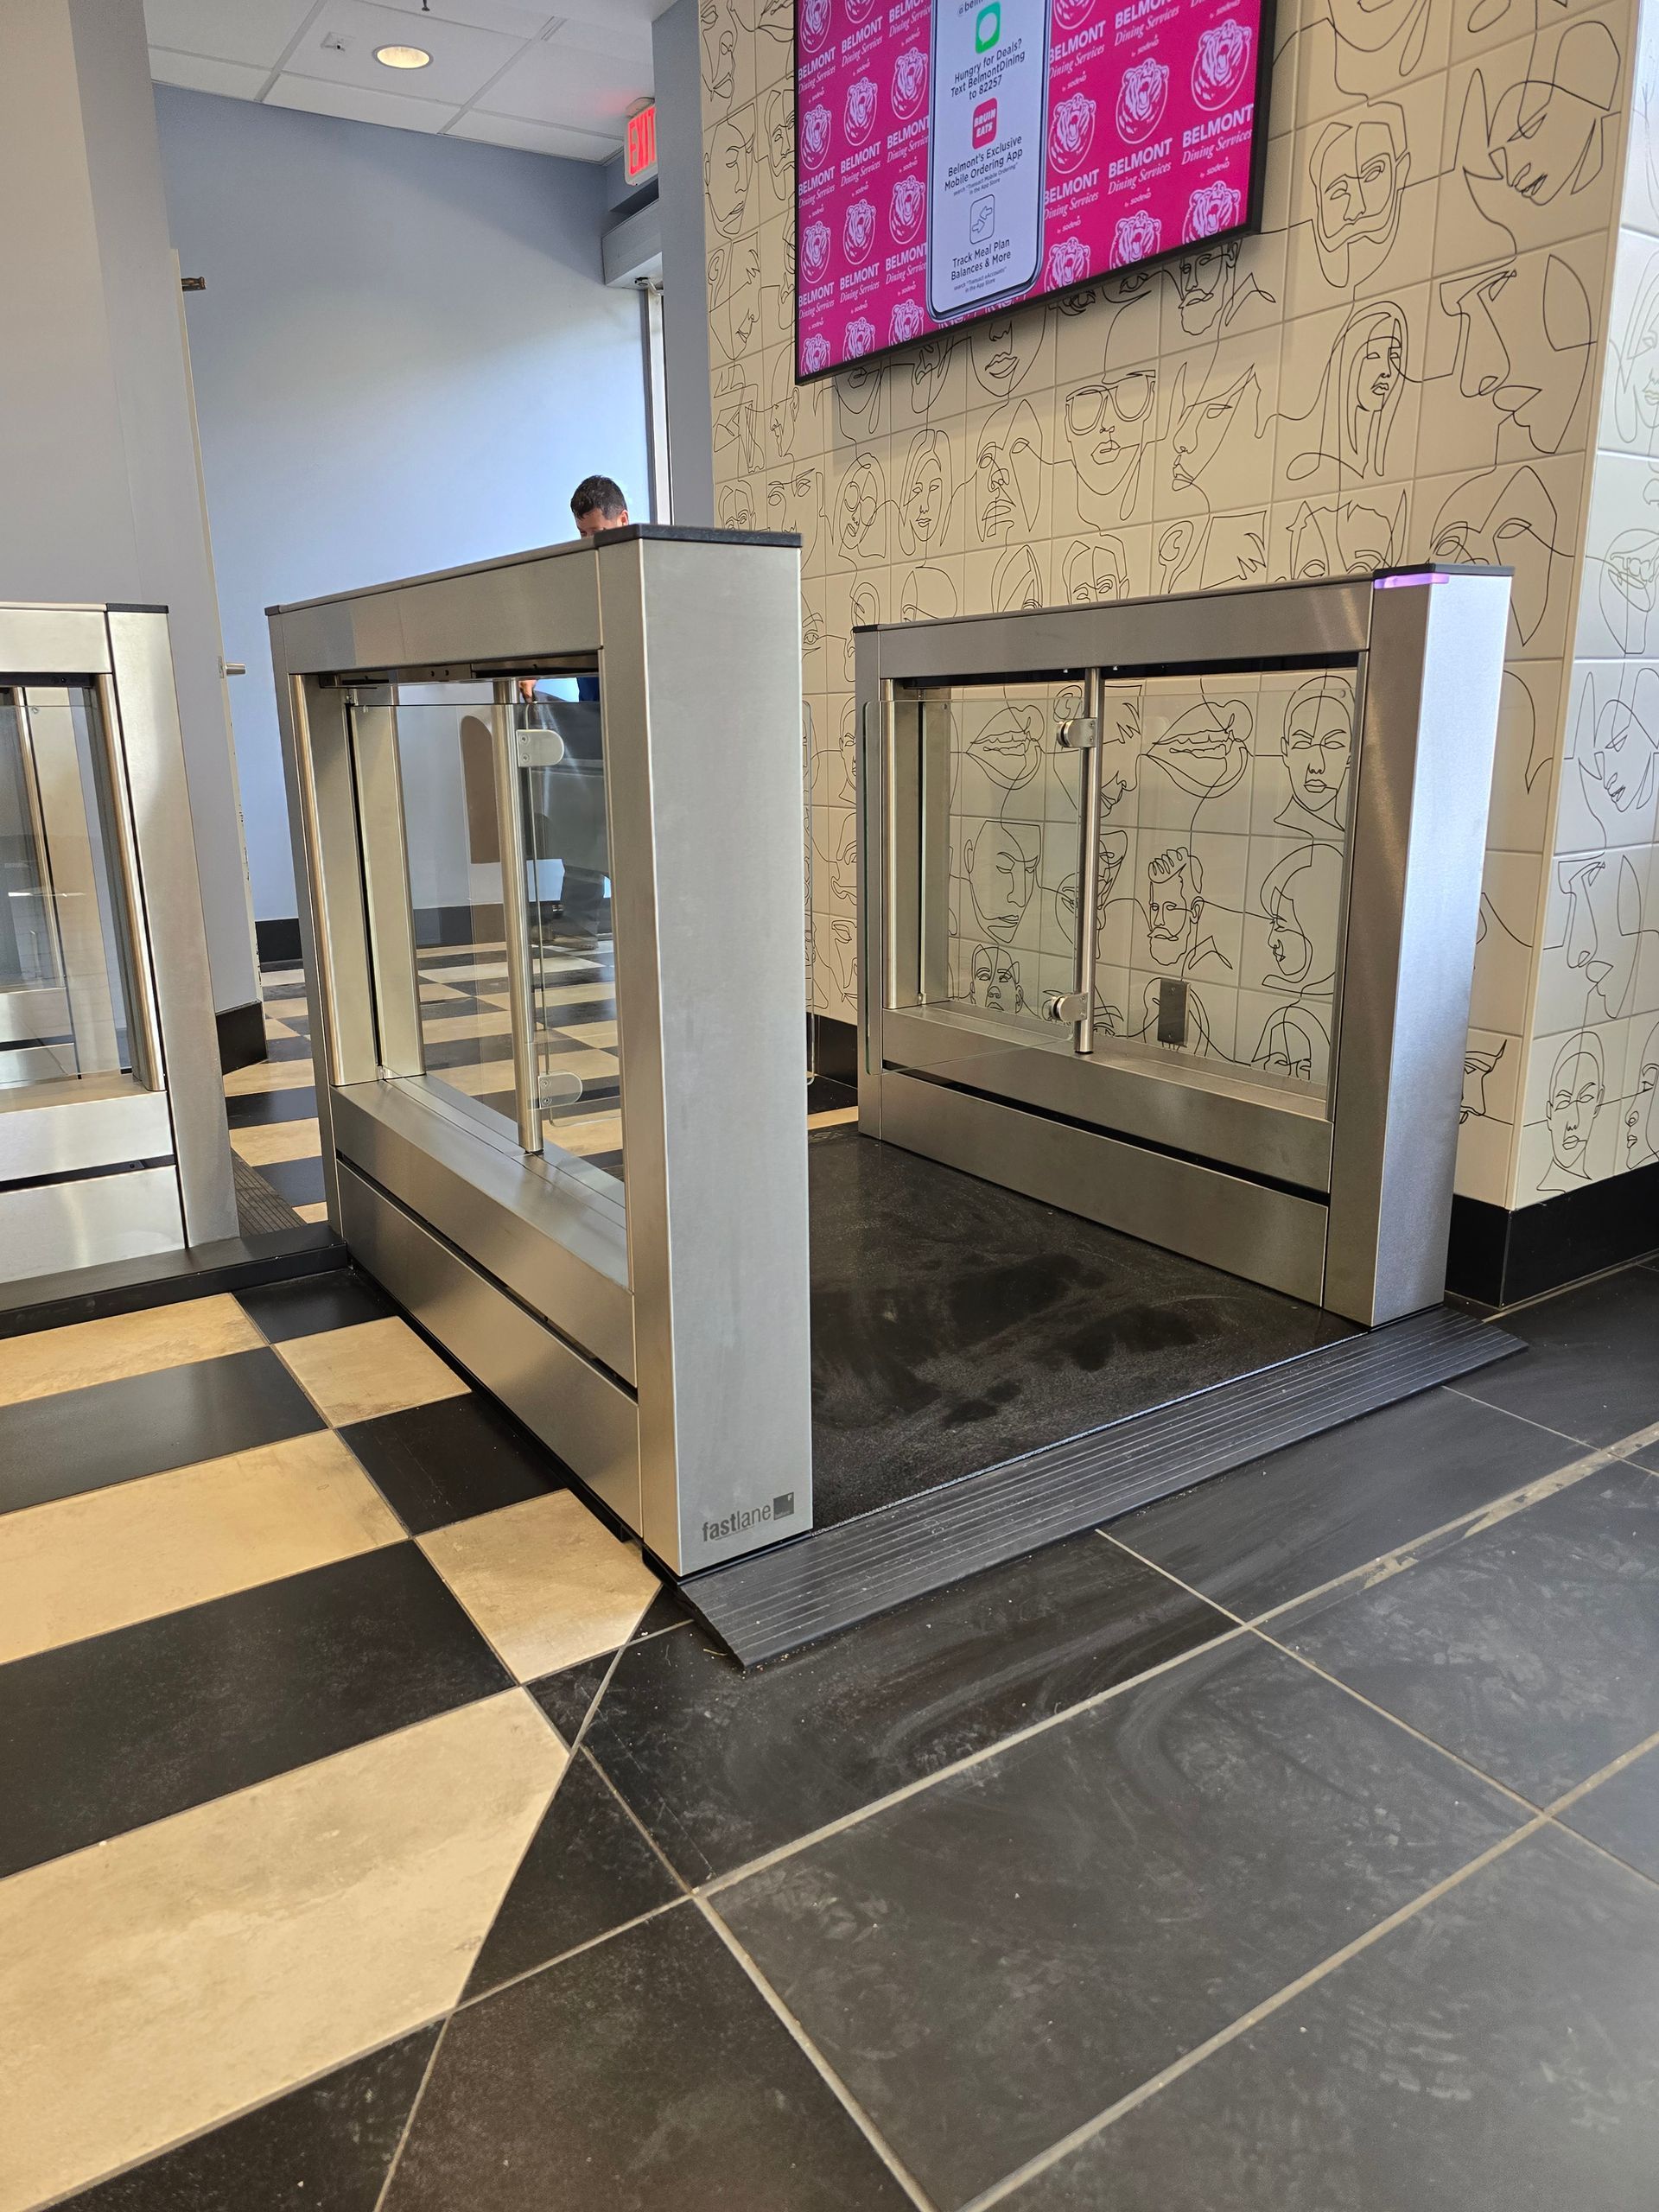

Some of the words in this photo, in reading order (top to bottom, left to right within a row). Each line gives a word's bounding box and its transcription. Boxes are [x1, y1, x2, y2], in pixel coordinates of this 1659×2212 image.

[1115, 0, 1172, 29] BELMO
[842, 16, 883, 54] BELMONT
[1049, 20, 1106, 64] BELMONT
[1115, 24, 1144, 47] Dining
[798, 47, 836, 80] BELMONT
[842, 51, 861, 67] Dining
[955, 62, 982, 84] Hungry
[983, 54, 995, 67] for
[996, 37, 1022, 60] Deals?
[1075, 44, 1105, 67] Services
[950, 84, 966, 98] Text
[968, 51, 1025, 88] BelmontDining
[969, 90, 976, 100] to
[979, 74, 1002, 95] 82257
[887, 115, 929, 149] BELMONT
[974, 108, 996, 128] BRUIN
[976, 122, 993, 138] EATS
[1182, 103, 1254, 149] BELMONT
[628, 105, 656, 176] EXIT
[887, 146, 907, 162] Dining
[1181, 144, 1215, 165] Dining
[1216, 129, 1253, 151] Services
[841, 141, 881, 174] BELMONT
[944, 174, 968, 191] Mobile
[970, 156, 1004, 179] Ordering
[1007, 148, 1022, 163] App
[948, 153, 984, 177] Belmont's
[986, 136, 1022, 159] Exclusive
[1109, 137, 1173, 178] BELMONT
[798, 166, 836, 196] BELMONT
[841, 170, 859, 188] Dining
[860, 161, 881, 178] Services
[1044, 168, 1100, 206] BELMONT
[1108, 176, 1137, 194] Dining
[1138, 162, 1172, 182] Services
[1044, 205, 1068, 220] Dining
[1069, 191, 1099, 211] Services
[886, 243, 926, 271] BELMONT
[950, 262, 982, 281] Balances
[984, 257, 990, 268] &
[992, 251, 1011, 265] More
[952, 251, 973, 269] Track
[974, 244, 992, 260] Meal
[994, 238, 1010, 252] Plan
[840, 263, 880, 290] BELMONT
[886, 270, 906, 285] Dining
[798, 282, 835, 308] BELMONT
[840, 287, 858, 303] Dining
[859, 281, 880, 296] Services
[702, 1504, 772, 1541] fastlane
